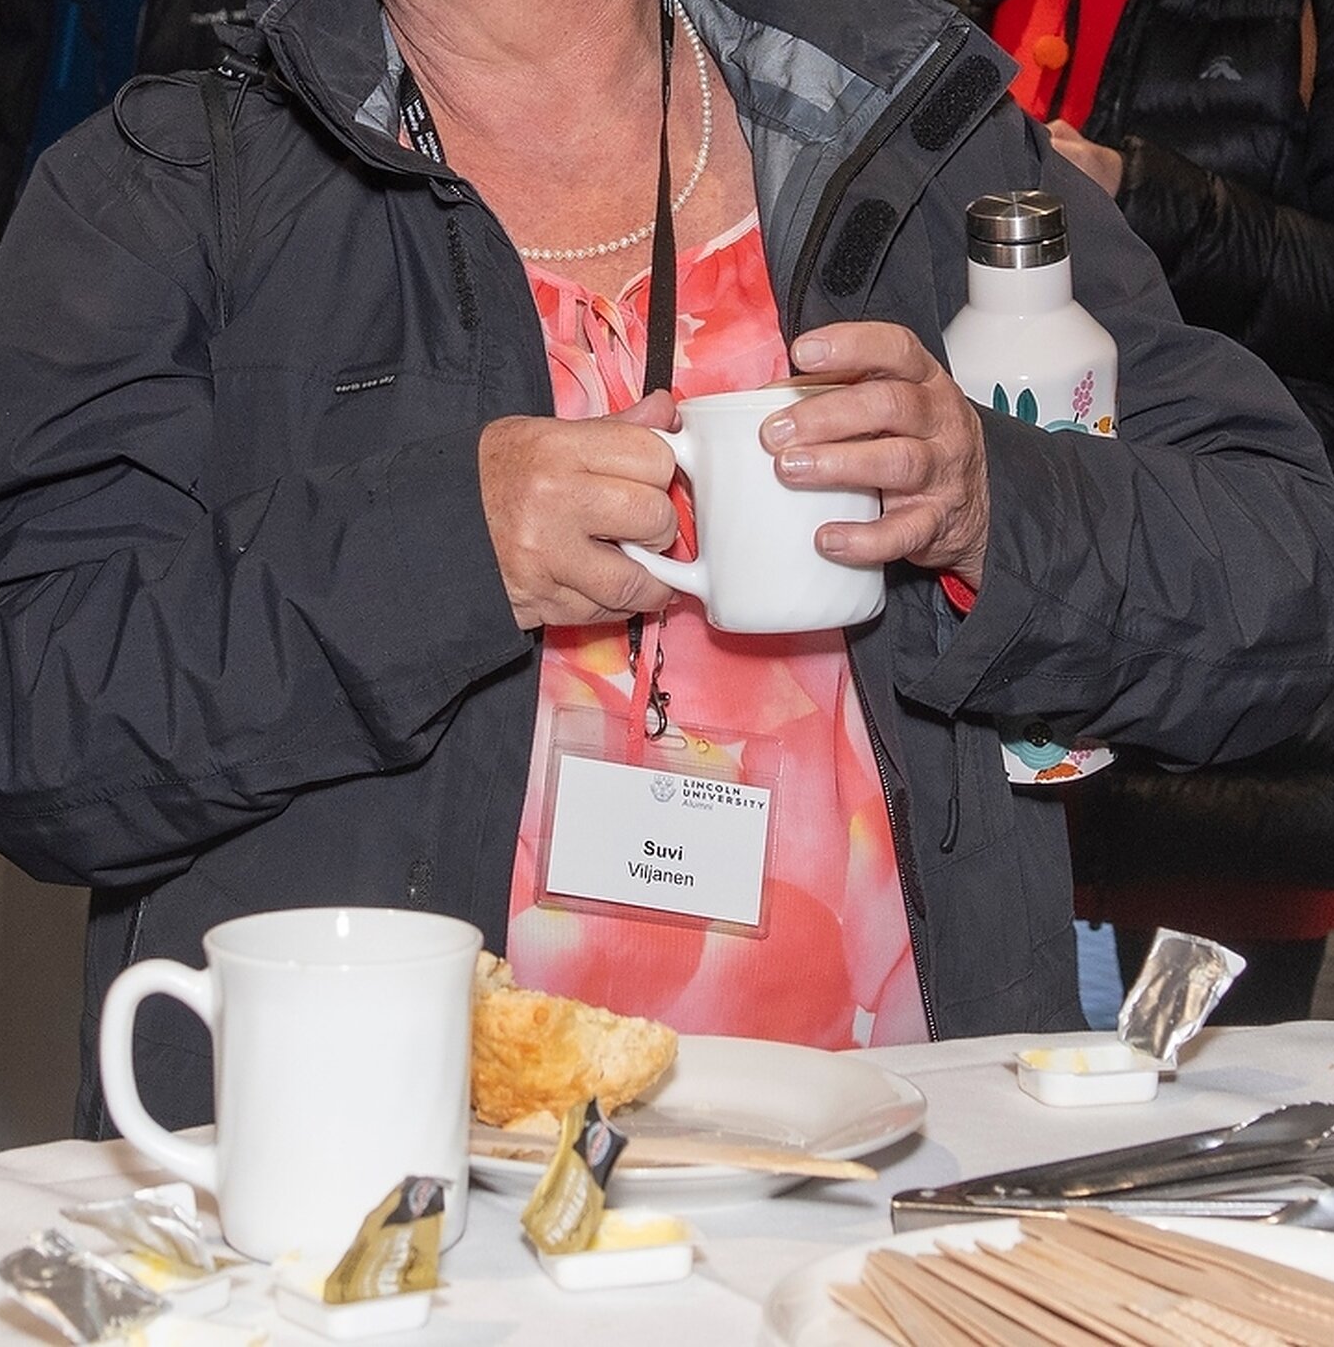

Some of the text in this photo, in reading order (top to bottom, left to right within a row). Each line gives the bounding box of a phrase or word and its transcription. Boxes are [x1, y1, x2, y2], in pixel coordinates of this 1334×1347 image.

[682, 779, 741, 795] LINCOLN
[682, 789, 765, 809] UNIVERSITY
[642, 839, 684, 861] Suvi
[626, 860, 695, 887] Viljanen
